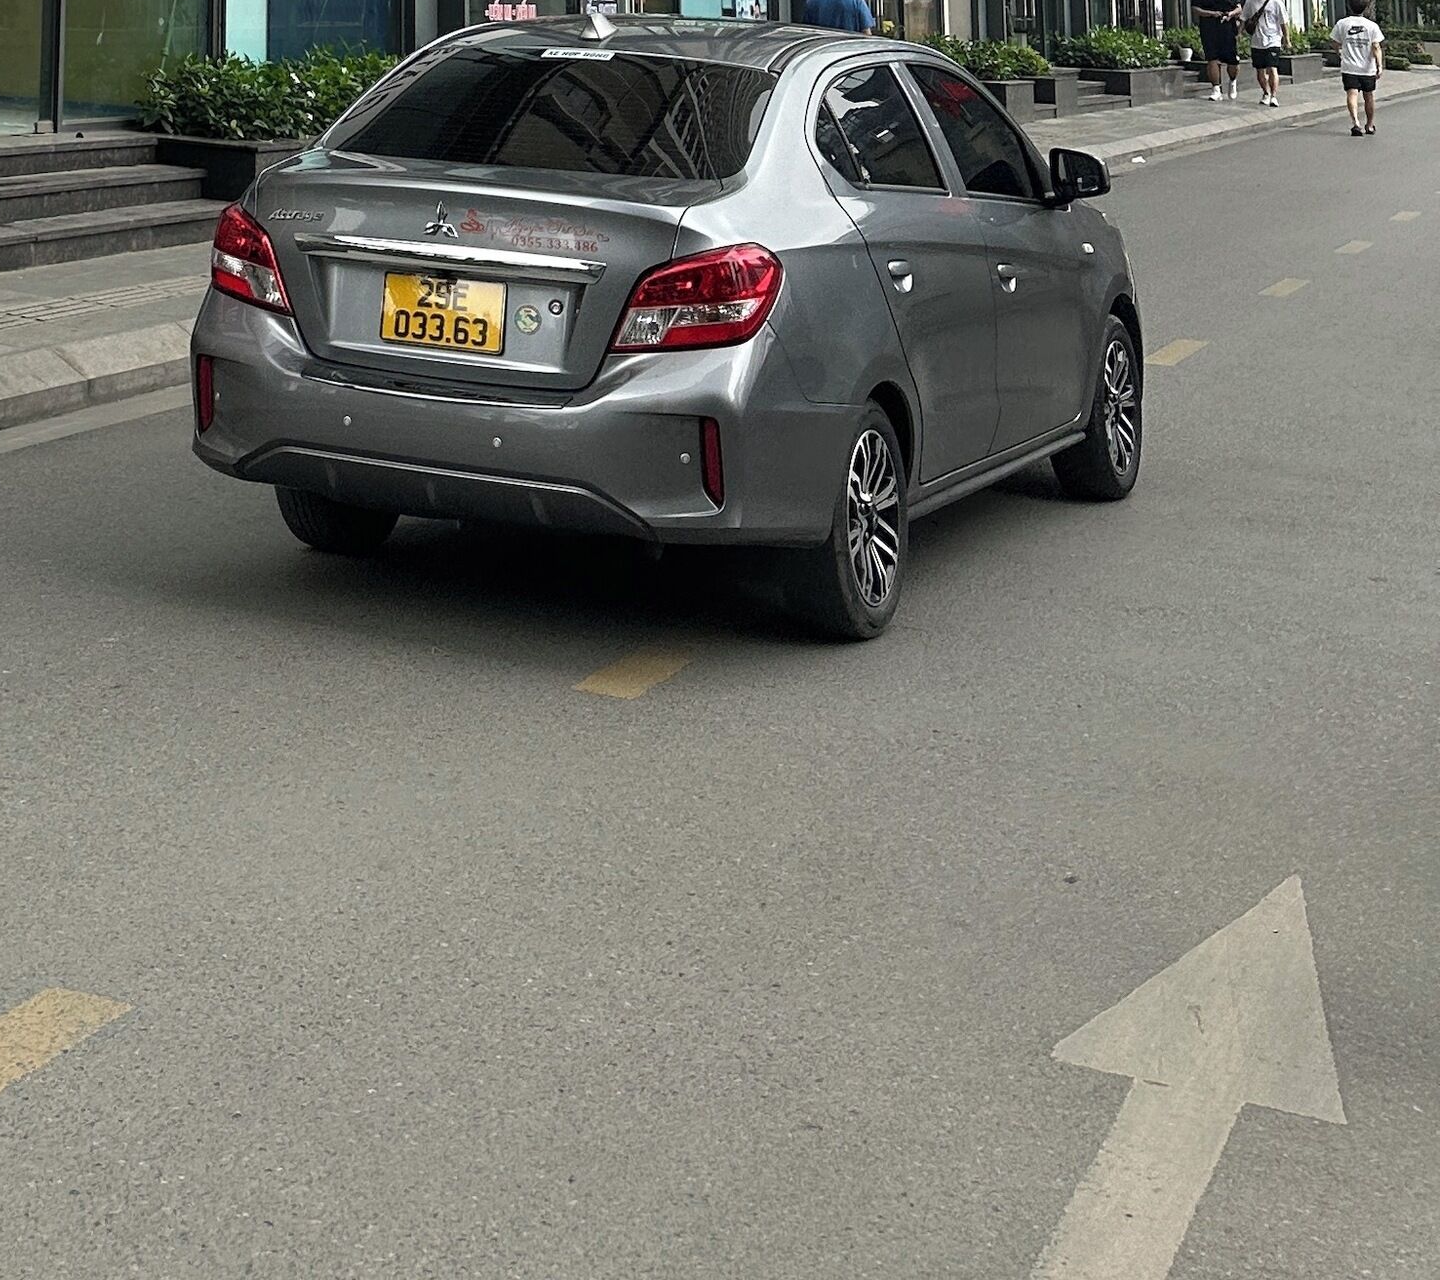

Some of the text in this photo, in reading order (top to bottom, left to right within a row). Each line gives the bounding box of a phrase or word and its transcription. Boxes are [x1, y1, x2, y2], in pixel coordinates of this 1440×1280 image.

[267, 207, 325, 223] Attrage
[416, 278, 470, 312] 29E
[394, 309, 490, 348] 033.63
